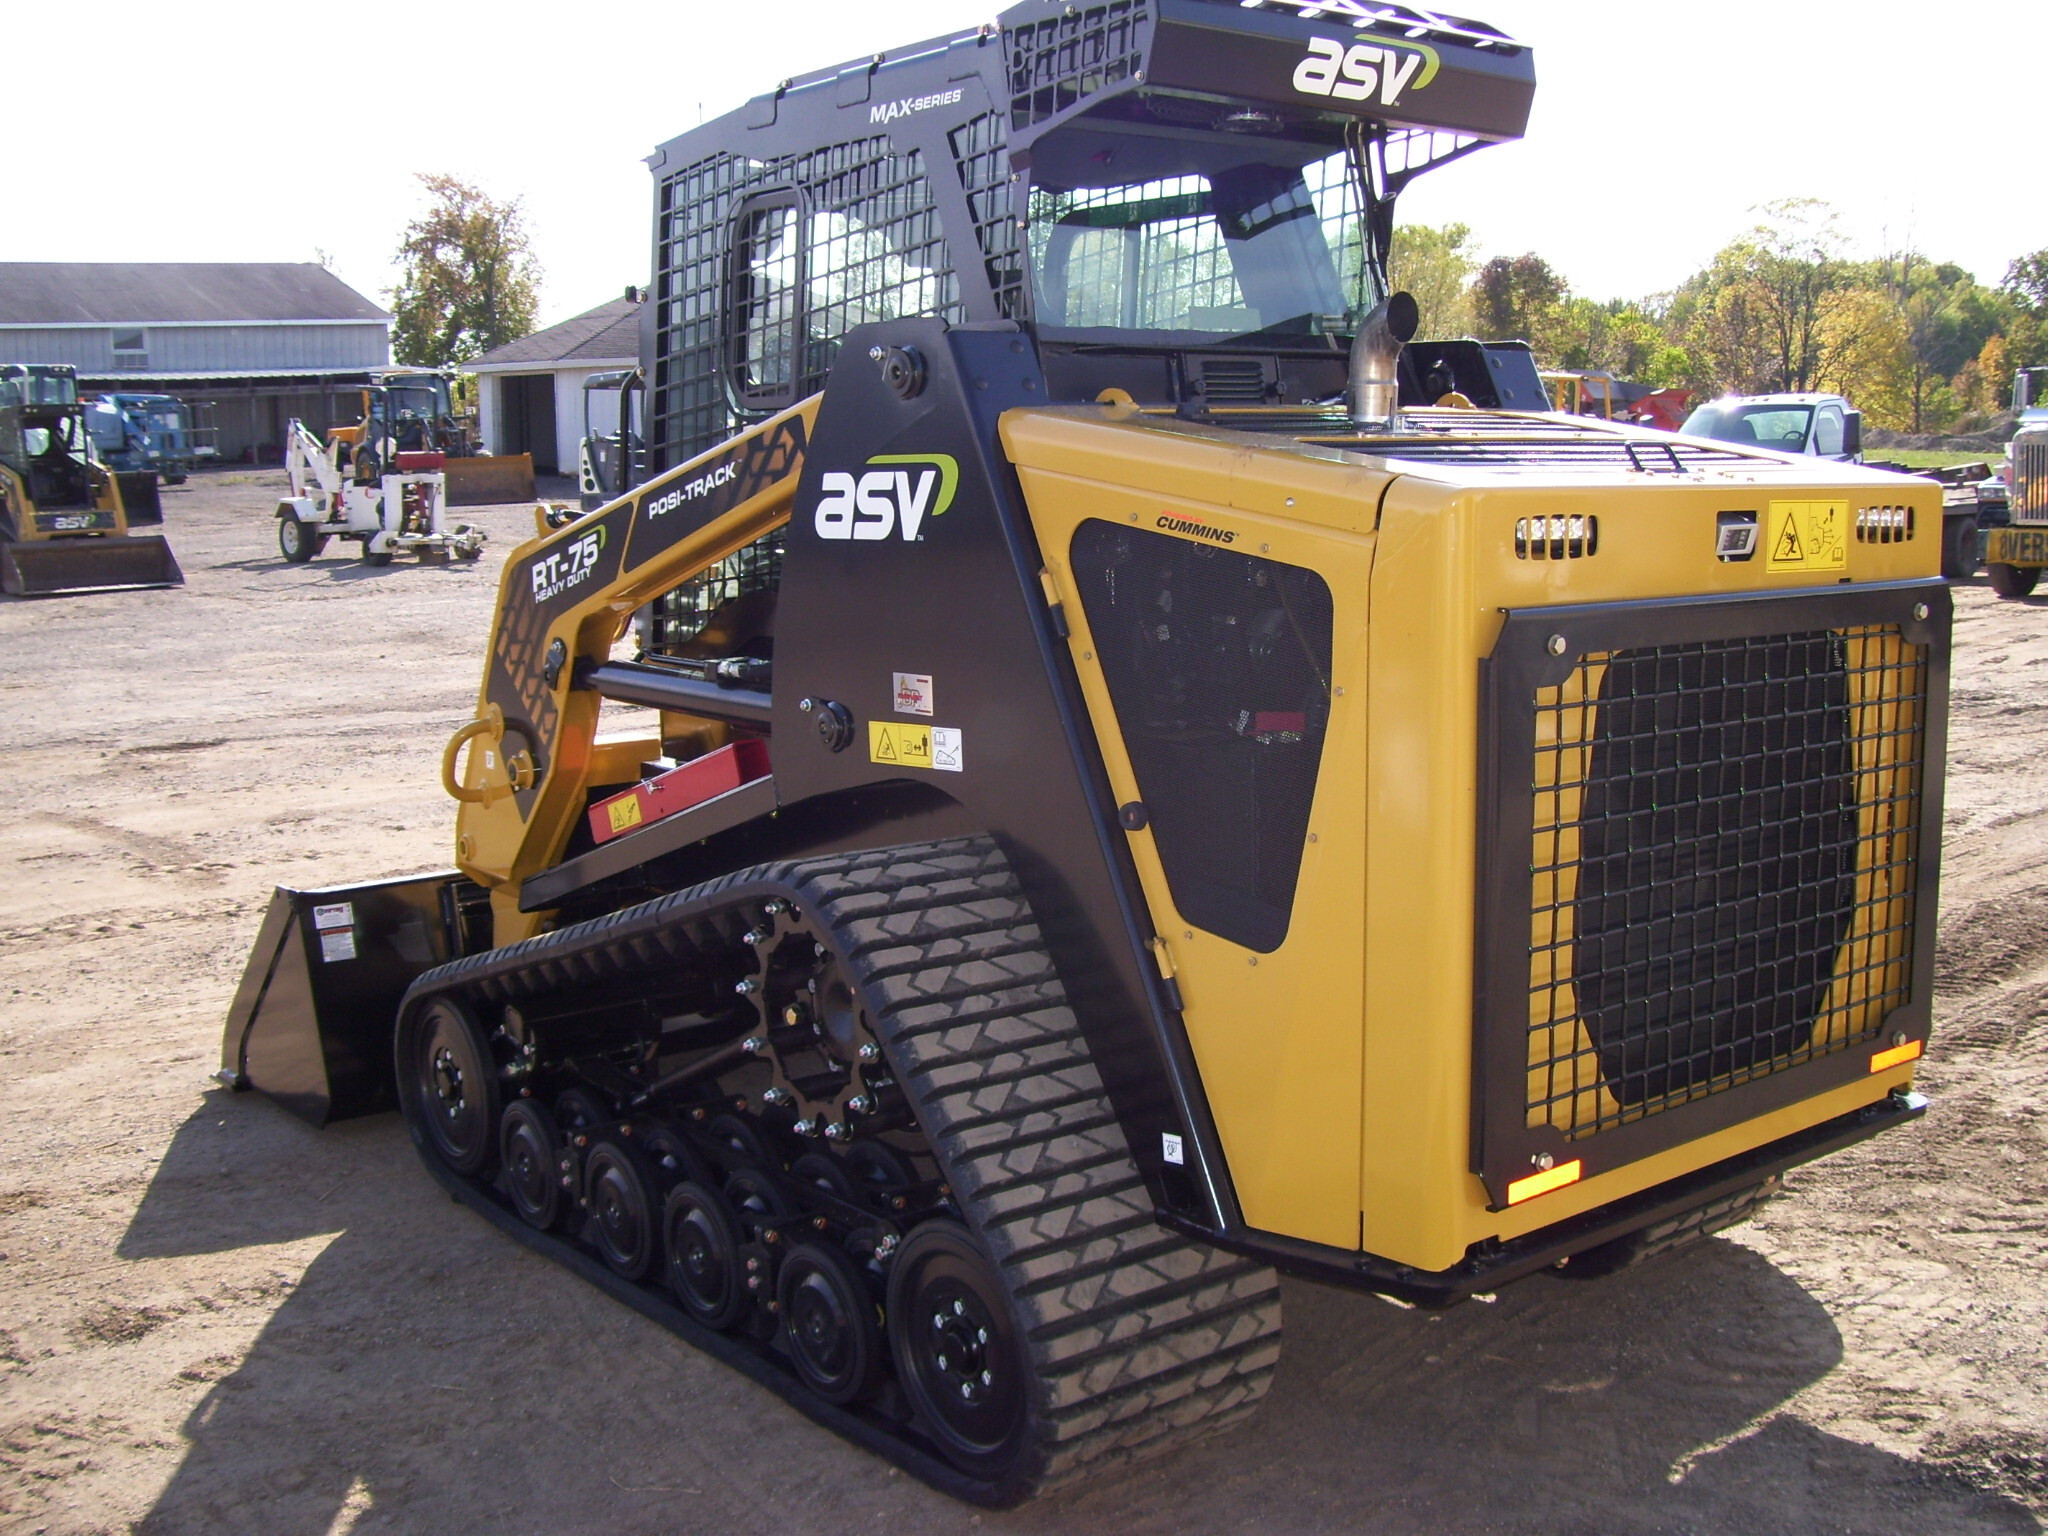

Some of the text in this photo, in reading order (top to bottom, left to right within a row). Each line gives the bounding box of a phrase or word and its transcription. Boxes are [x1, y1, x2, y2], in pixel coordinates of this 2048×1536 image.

[869, 88, 962, 124] MAX-SERIES
[648, 461, 737, 520] POSI-TRACK
[1156, 516, 1236, 544] CUMMINS
[532, 532, 599, 593] RT-75
[535, 565, 592, 604] HEAVY DUTY
